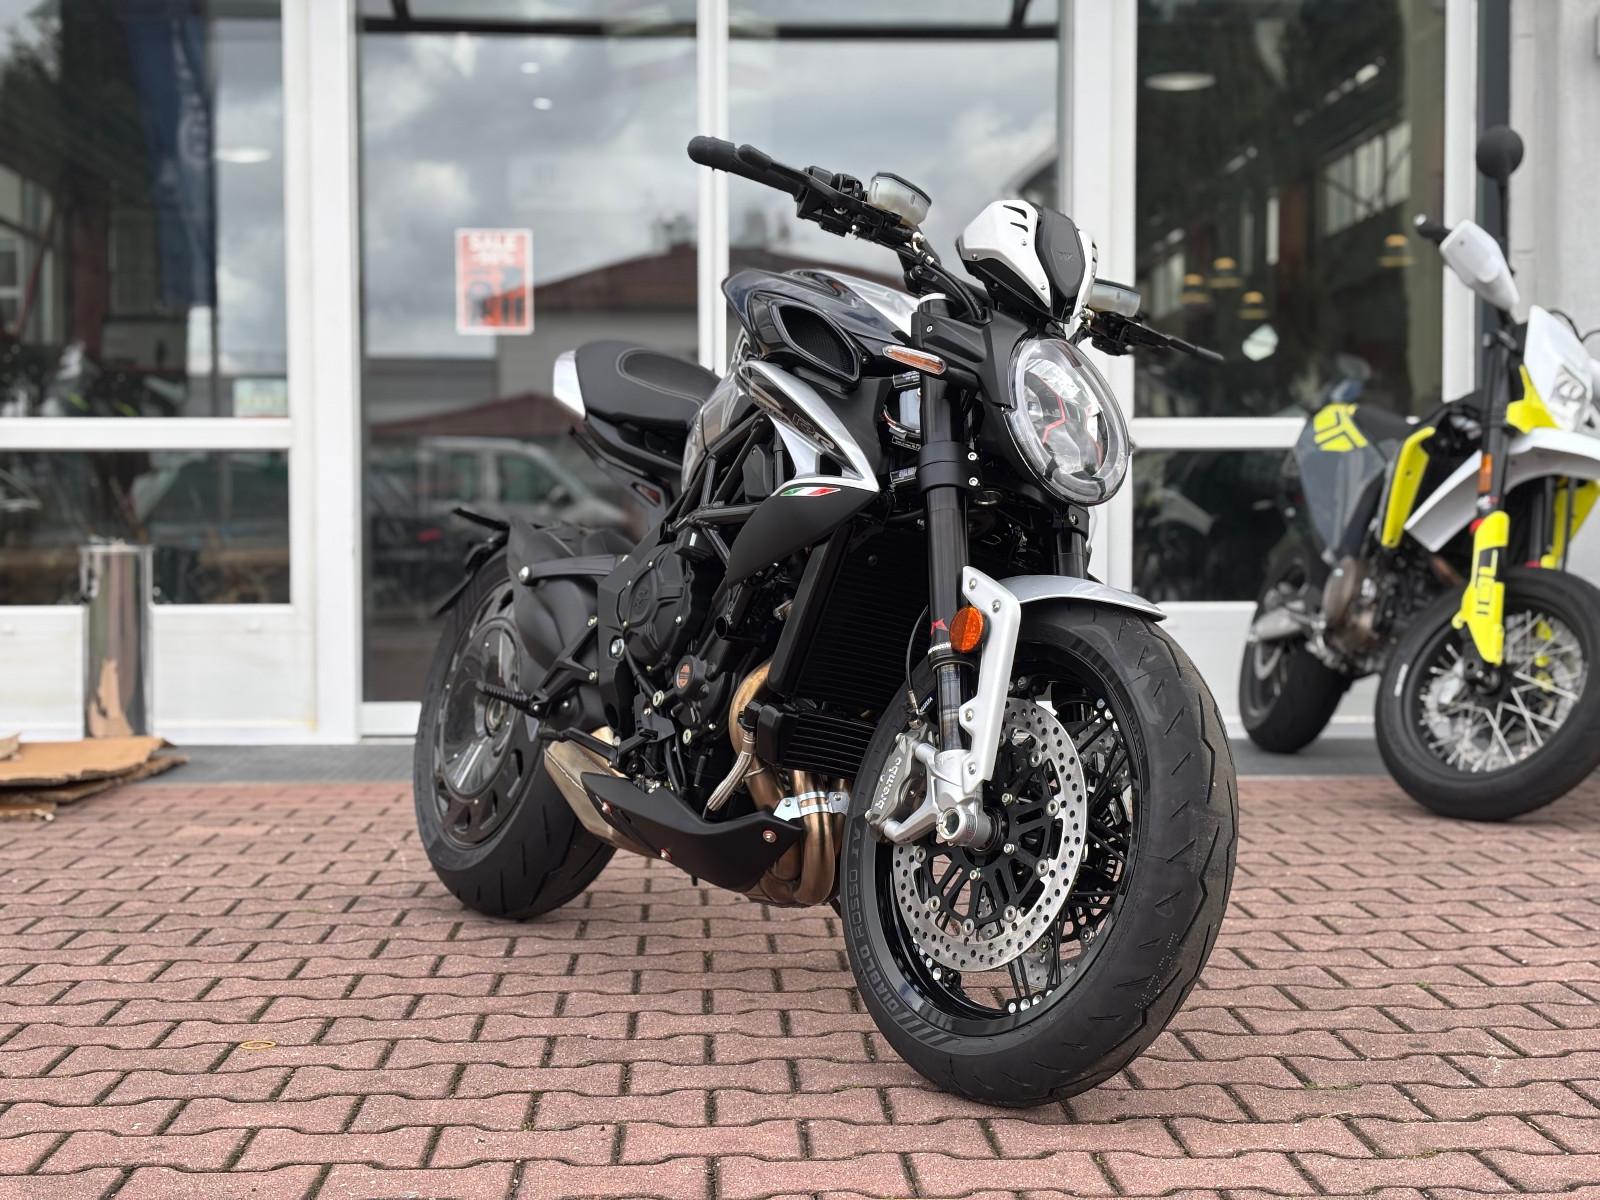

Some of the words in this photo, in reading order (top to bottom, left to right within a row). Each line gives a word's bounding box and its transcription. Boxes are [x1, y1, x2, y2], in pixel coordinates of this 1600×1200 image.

[874, 756, 902, 810] brembo
[849, 868, 866, 939] ROSSO
[860, 942, 899, 1013] DIABLO
